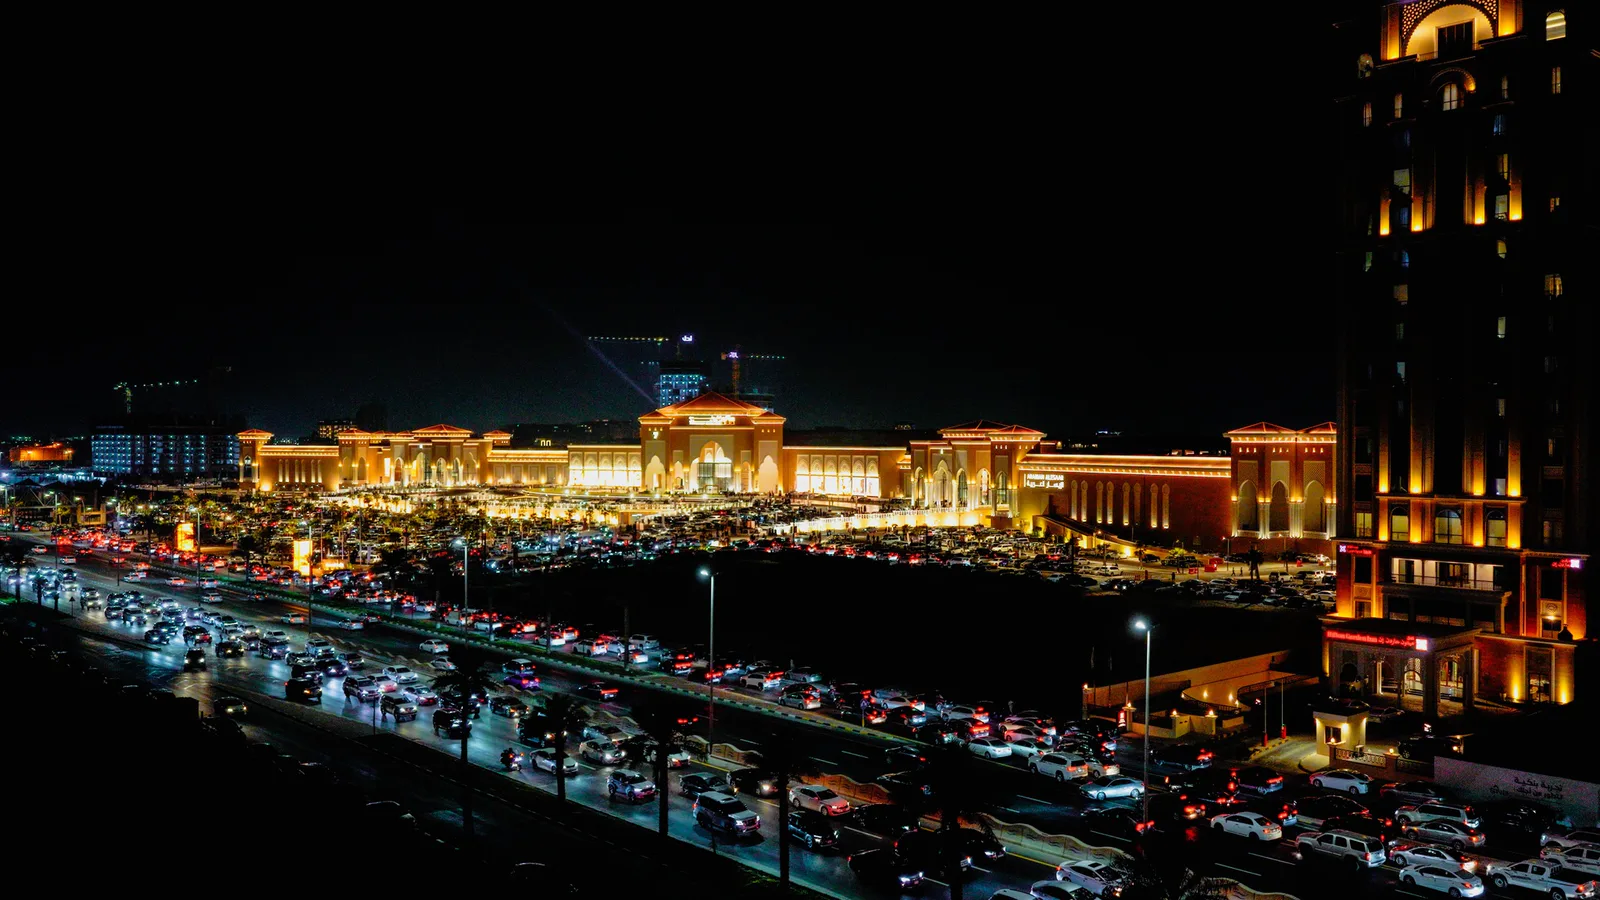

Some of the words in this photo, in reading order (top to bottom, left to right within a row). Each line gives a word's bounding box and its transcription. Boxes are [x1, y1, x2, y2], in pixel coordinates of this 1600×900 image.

[1327, 630, 1345, 639] Hilton
[1345, 633, 1366, 642] Garden
[1367, 635, 1378, 643] Inn
[1514, 777, 1538, 787] بنكية
